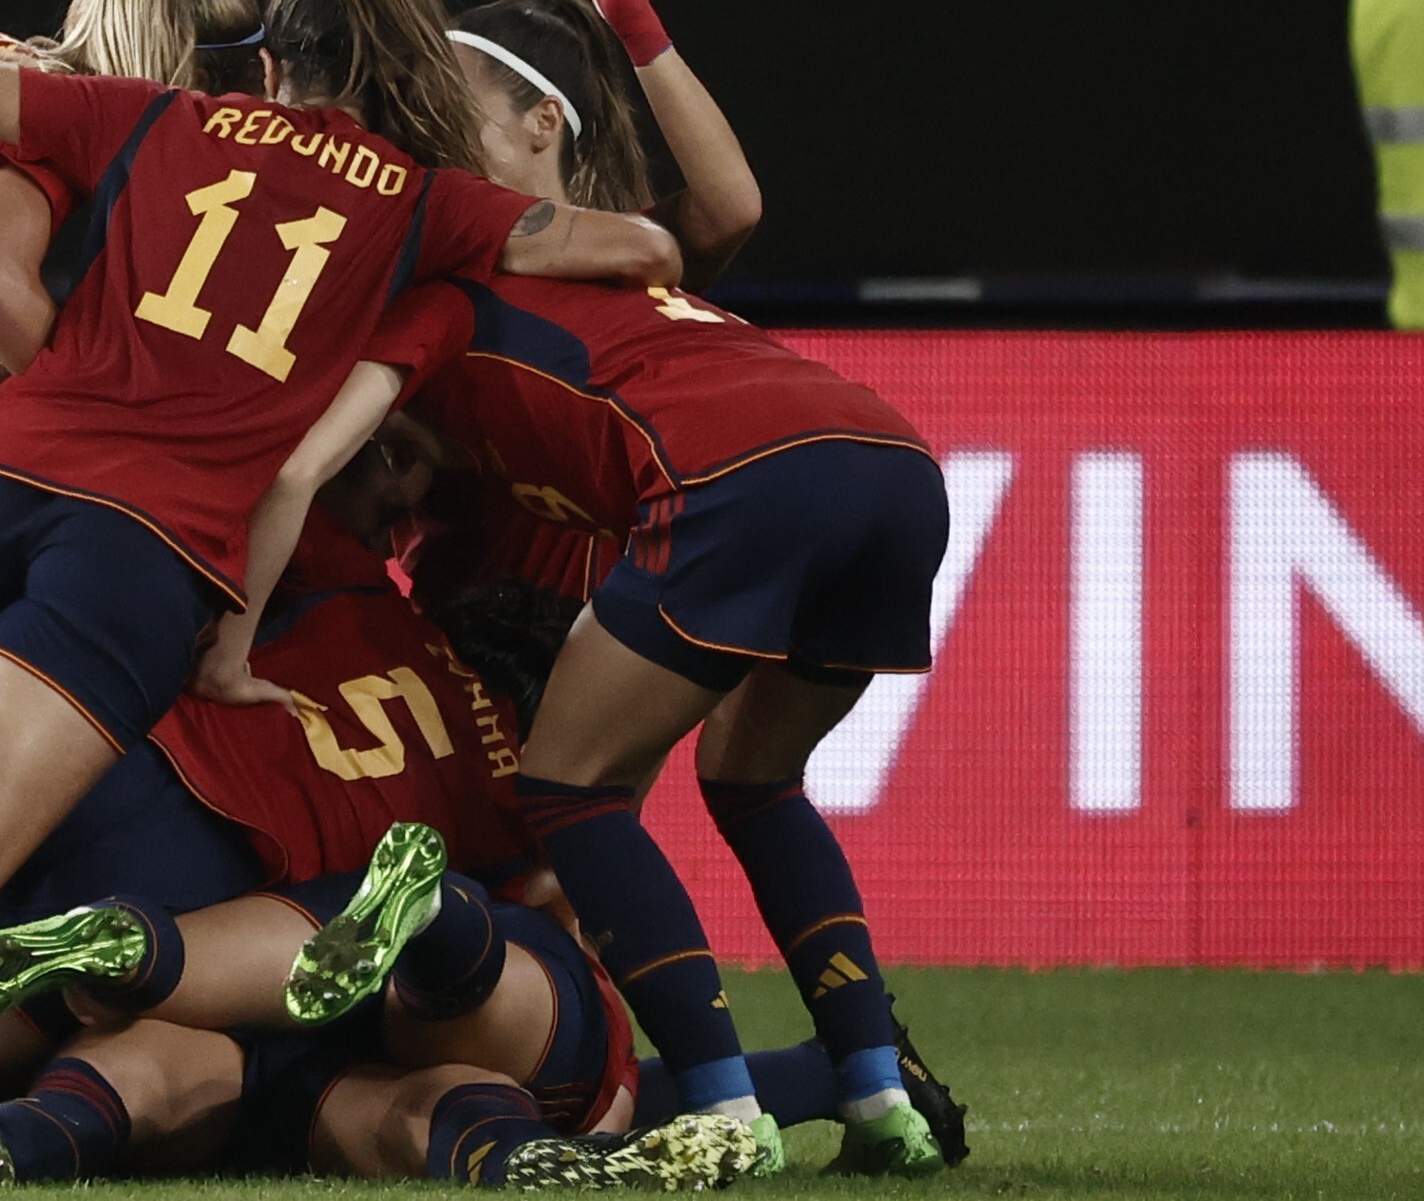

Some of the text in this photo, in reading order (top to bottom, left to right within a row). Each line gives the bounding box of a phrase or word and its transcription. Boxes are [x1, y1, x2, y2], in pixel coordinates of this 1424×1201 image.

[201, 106, 409, 197] REDUNDO
[133, 168, 349, 384] 11
[289, 665, 455, 782] 5
